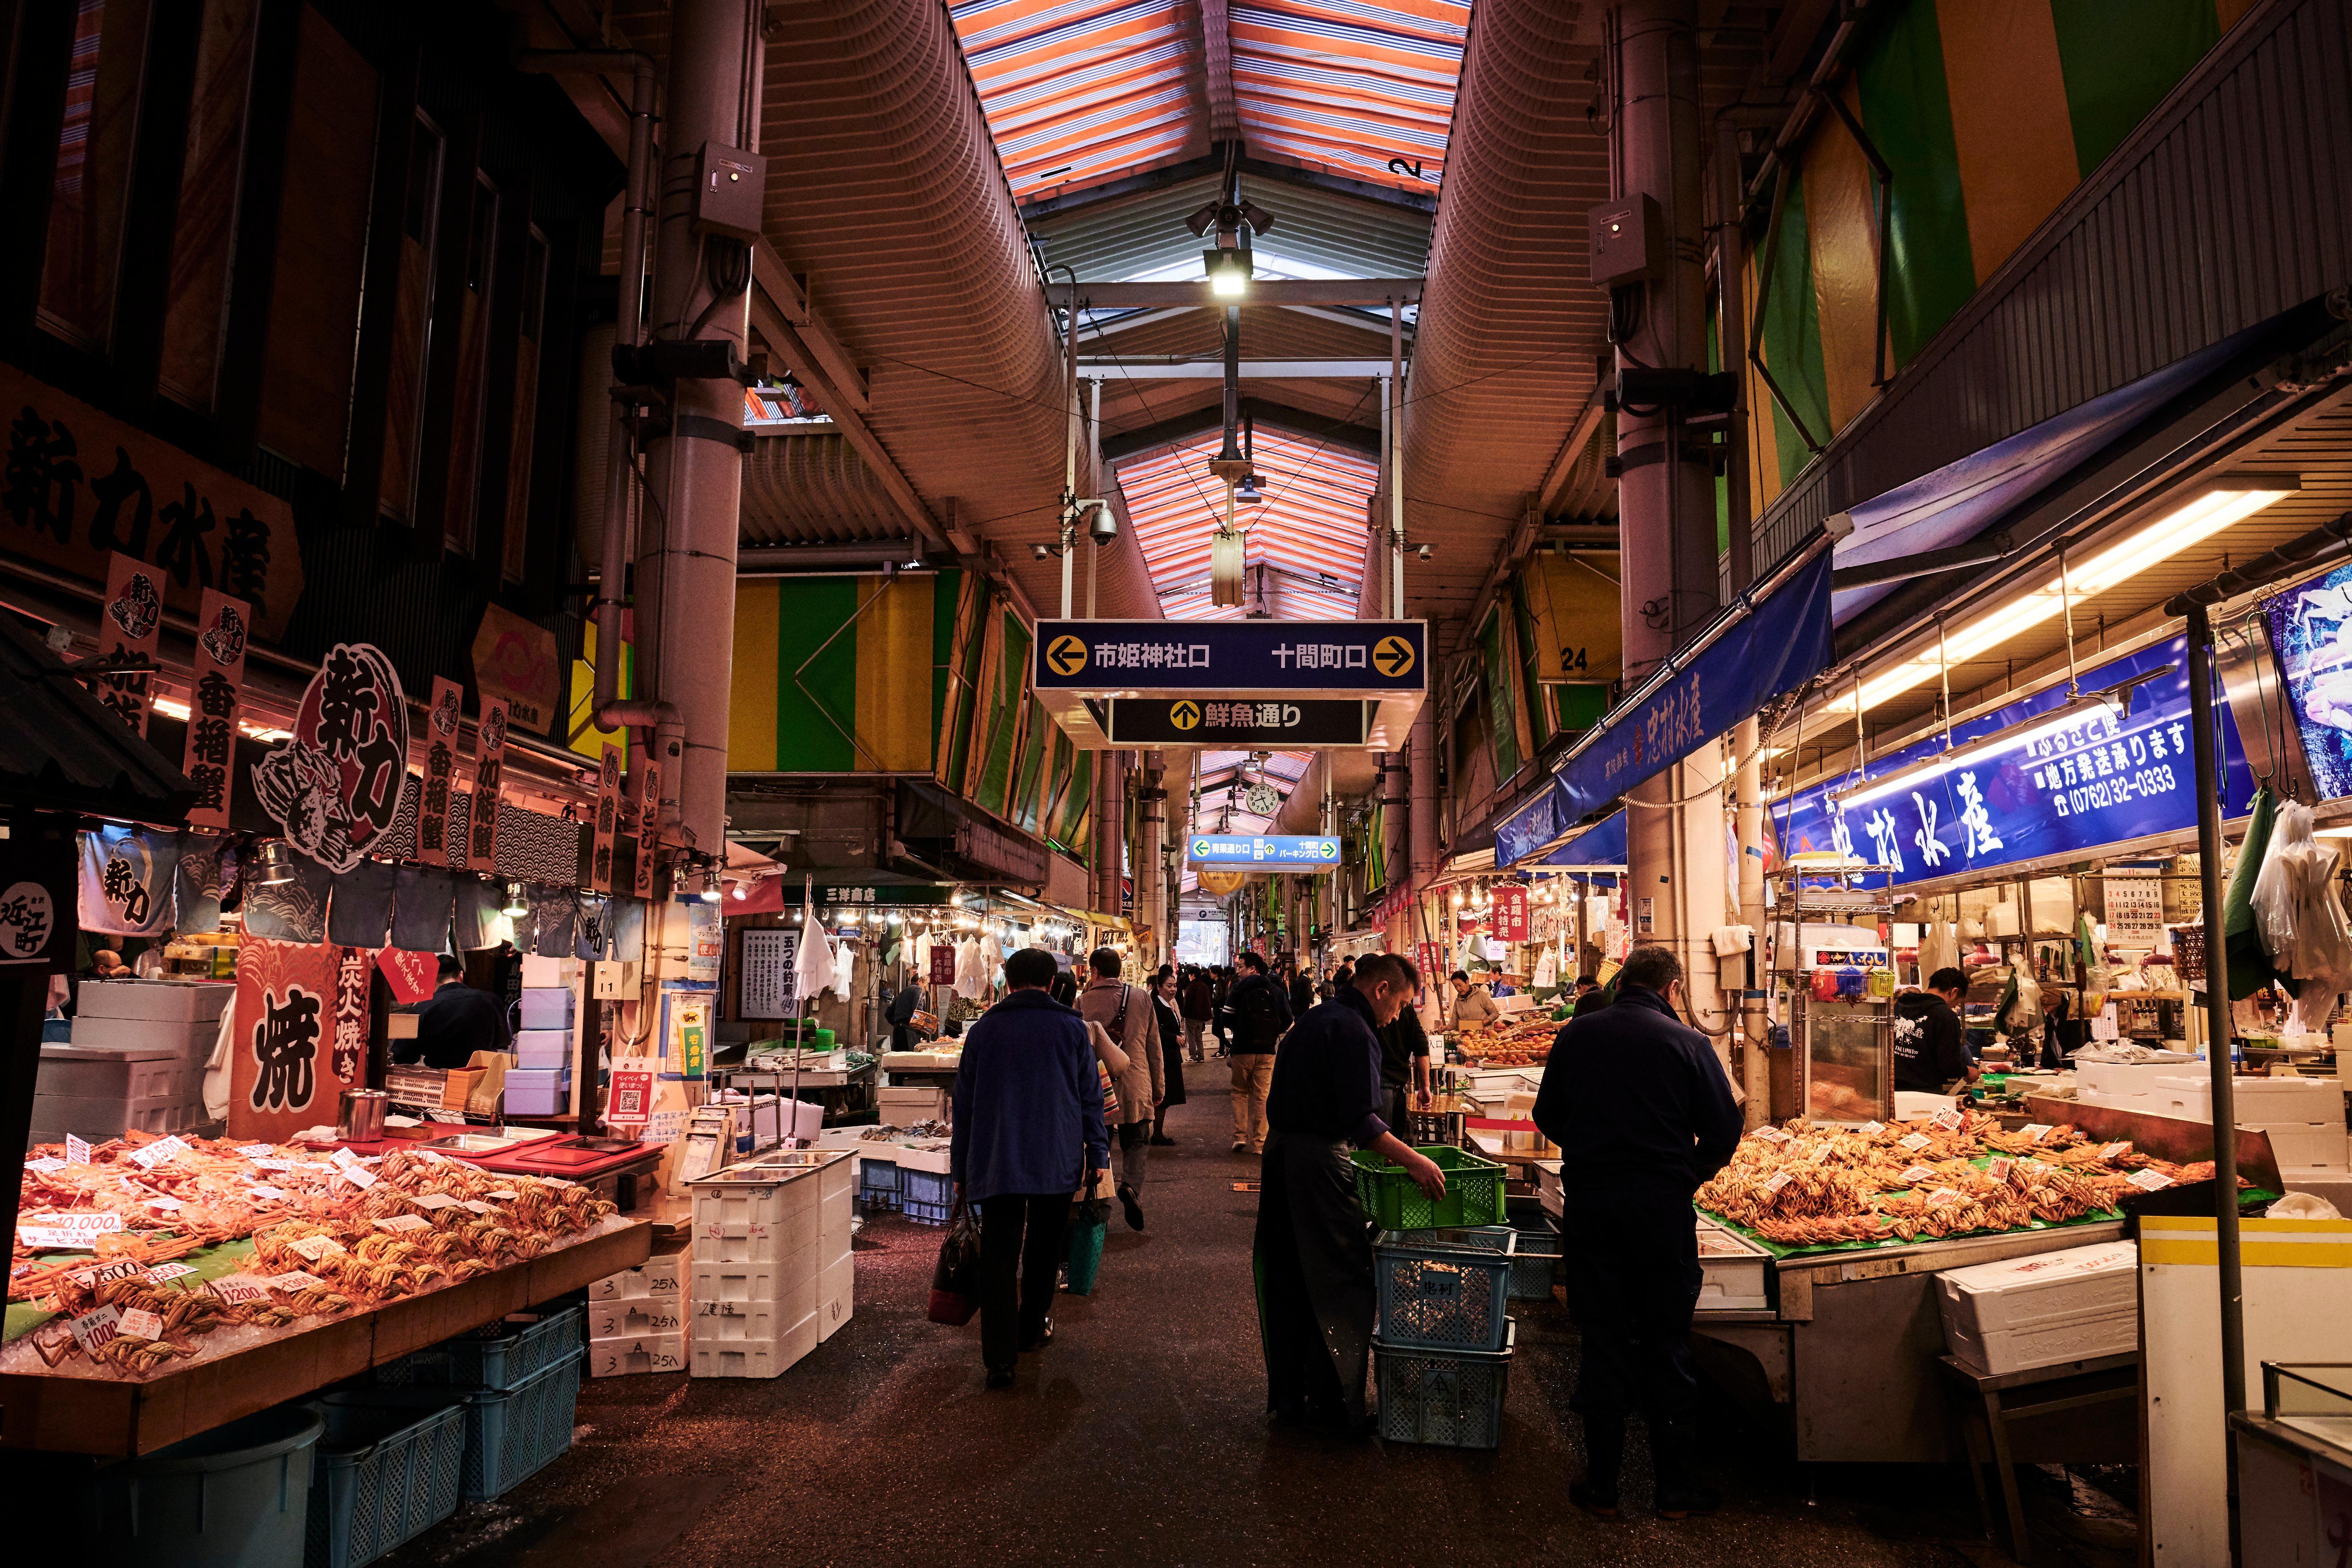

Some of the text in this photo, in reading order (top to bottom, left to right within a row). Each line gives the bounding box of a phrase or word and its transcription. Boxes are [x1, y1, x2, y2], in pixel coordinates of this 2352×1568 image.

[2, 406, 271, 619] 新力水産
[130, 573, 160, 628] 新力
[219, 604, 244, 658] 新力
[1094, 642, 1366, 669] 市姫神社口 十間町口
[1562, 648, 1587, 671] 24
[1205, 702, 1300, 727] 鮮魚通り
[318, 648, 399, 830] 新力
[2039, 712, 2121, 757] ふるさと便
[2045, 722, 2185, 790] 地方発送承ります
[422, 740, 452, 851] 香箱蟹
[2069, 764, 2176, 814] (0762)32-0333
[472, 754, 499, 860] 加能蟹
[637, 805, 656, 890] どじょう
[1211, 841, 1318, 854] 青果通り口 十間町
[1279, 850, 1319, 859] パーキング口
[31, 896, 44, 905] 金沢
[104, 858, 150, 924] 新力
[827, 888, 876, 902] 三洋商店
[1, 895, 48, 952] 近江町
[1498, 904, 1509, 937] 大特売
[1510, 893, 1522, 927] 金曜市
[783, 936, 794, 996] 五つの約束
[934, 960, 942, 982] 大特売
[944, 950, 952, 977] 金曜市
[1849, 953, 1884, 966] いわし
[335, 956, 364, 1084] 炭火焼き
[253, 989, 320, 1108] 焼
[689, 1034, 700, 1067] 宅急便
[1429, 1040, 1443, 1048] 入口
[48, 1230, 88, 1238] 足折れ
[219, 1282, 247, 1290] 香箱ガニ
[604, 1280, 614, 1293] 3
[1423, 1281, 1455, 1296] 忠村
[81, 1312, 108, 1330] 香箱ガニ
[124, 1313, 144, 1331] 足折れ
[630, 1306, 637, 1315] A
[603, 1319, 615, 1333] 3
[634, 1342, 642, 1353] A
[605, 1357, 617, 1373] 3
